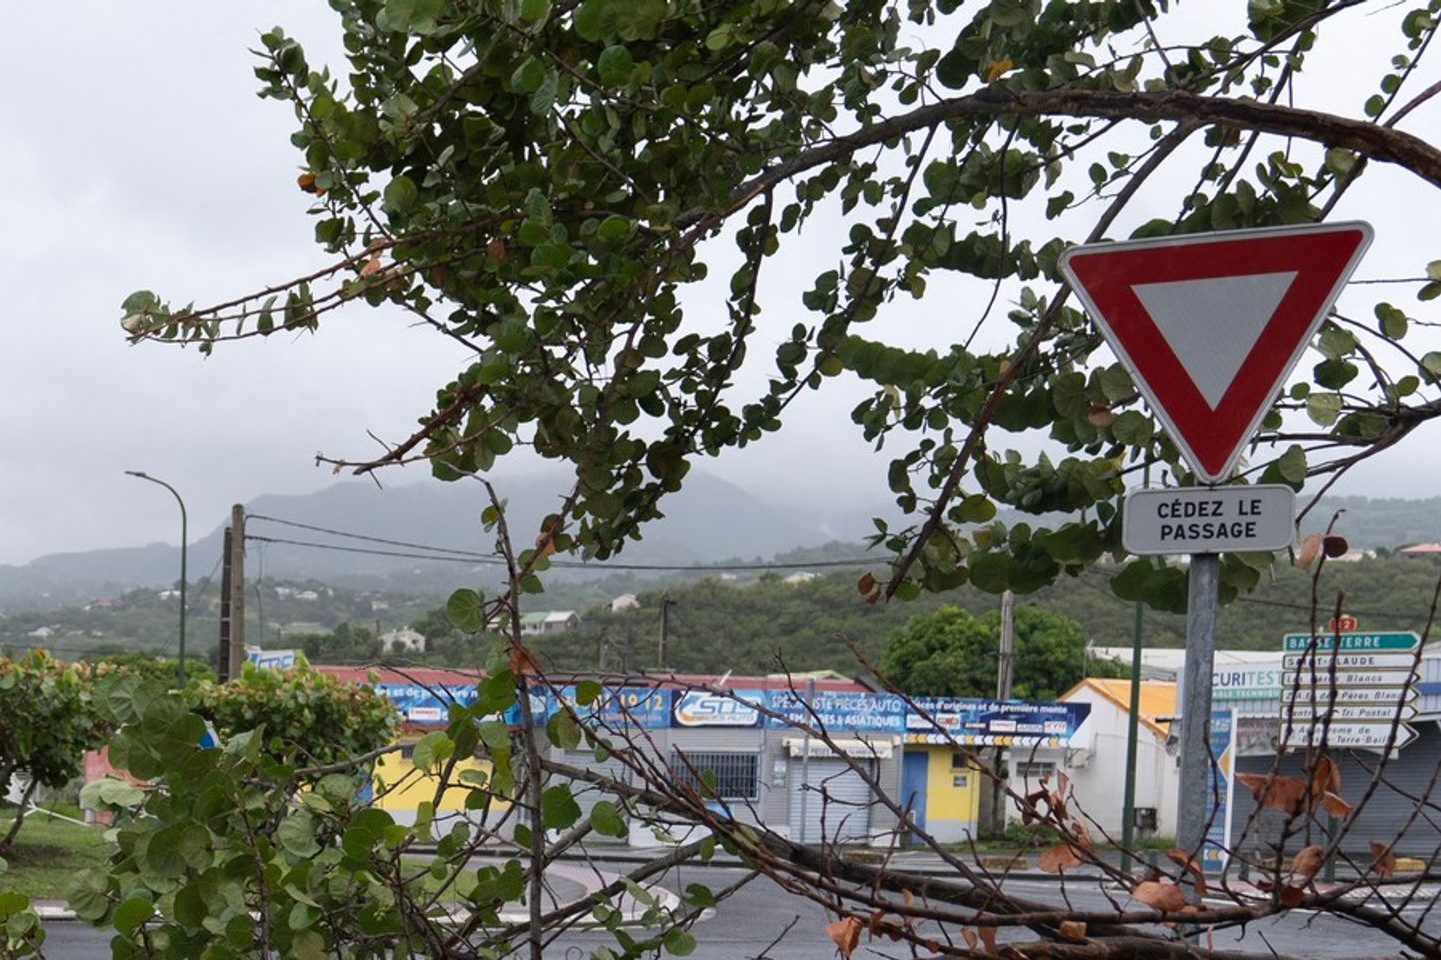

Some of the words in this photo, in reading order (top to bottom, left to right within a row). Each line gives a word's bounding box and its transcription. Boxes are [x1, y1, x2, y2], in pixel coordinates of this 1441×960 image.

[1158, 499, 1223, 519] CÉDEZ
[1238, 499, 1262, 516] LE
[1161, 522, 1257, 540] PASSAGE
